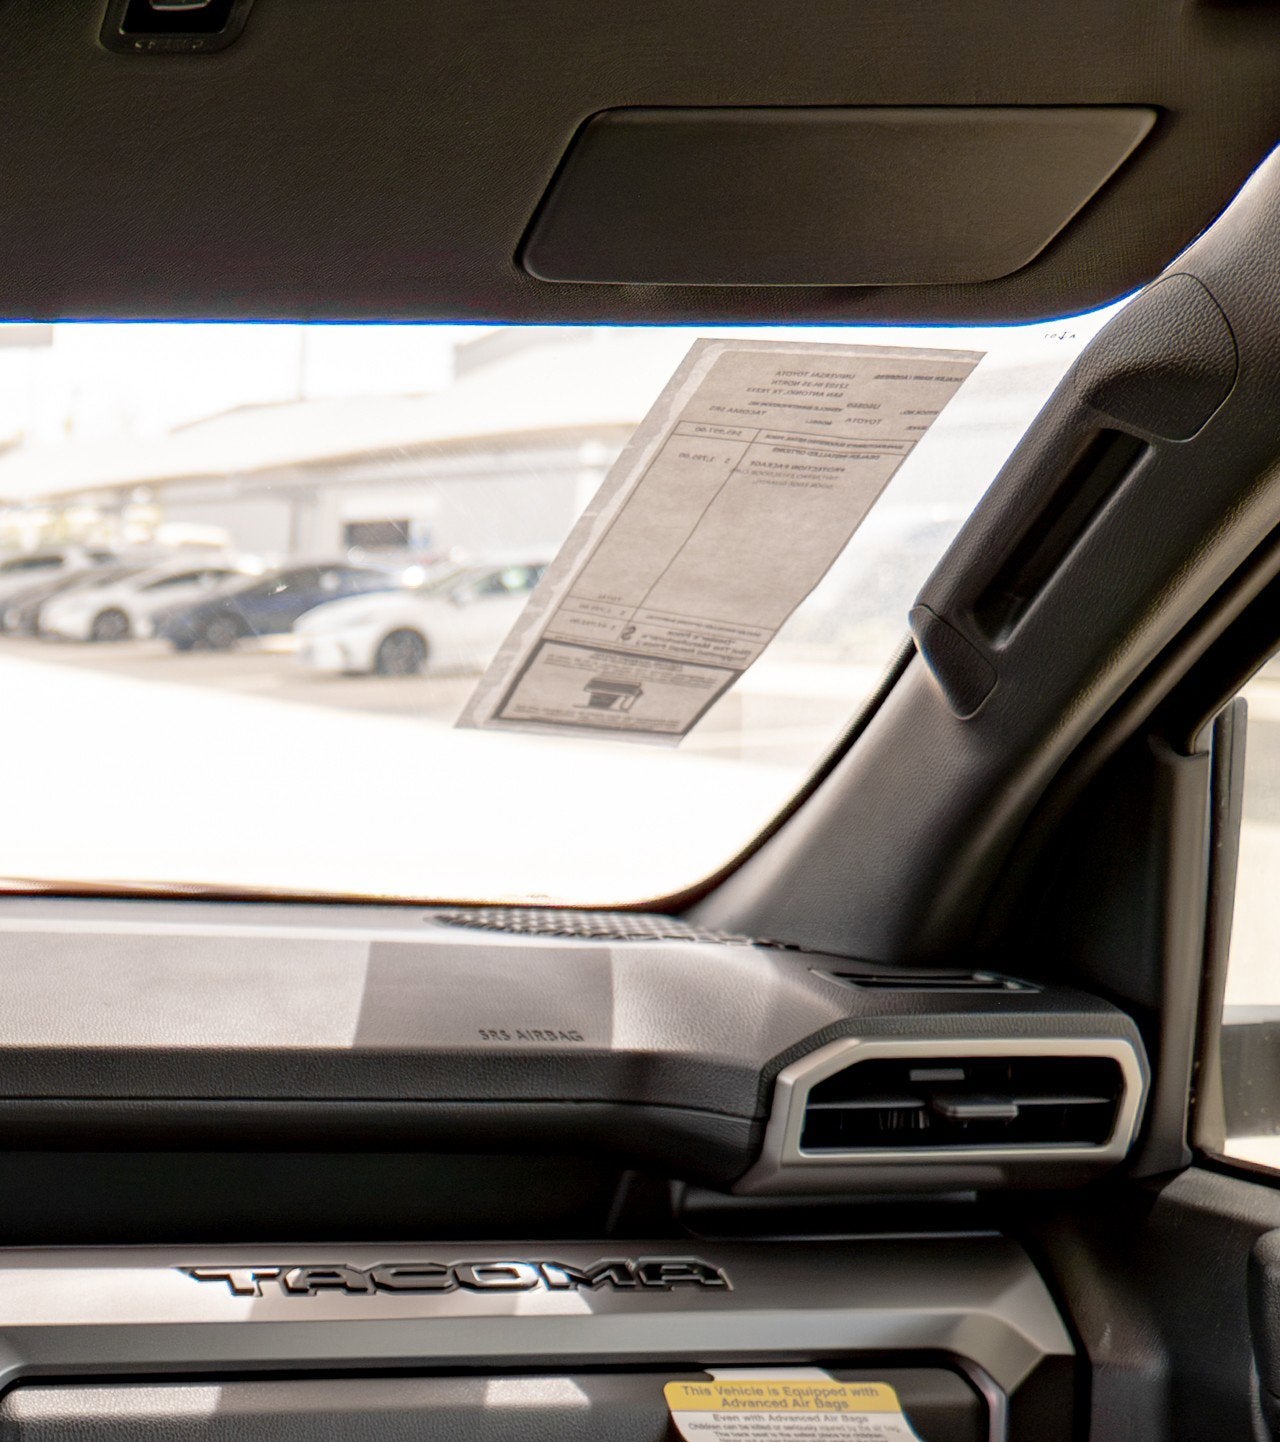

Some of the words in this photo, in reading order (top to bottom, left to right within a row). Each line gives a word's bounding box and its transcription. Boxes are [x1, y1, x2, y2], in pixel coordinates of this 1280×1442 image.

[478, 1029, 511, 1042] SRS
[516, 1029, 585, 1042] AIRBAG
[180, 1257, 734, 1297] TACOMA
[682, 1386, 712, 1396] This
[715, 1386, 764, 1396] Vehicle
[768, 1386, 780, 1396] is
[782, 1387, 847, 1399] Equipped
[850, 1387, 879, 1397] with
[721, 1399, 788, 1408] Advanced
[792, 1399, 810, 1408] Air
[814, 1399, 849, 1411] Bags
[712, 1414, 740, 1422] Even
[742, 1414, 765, 1422] with
[768, 1414, 820, 1422] Advanced
[823, 1414, 838, 1422] Air
[841, 1414, 869, 1422] Bags
